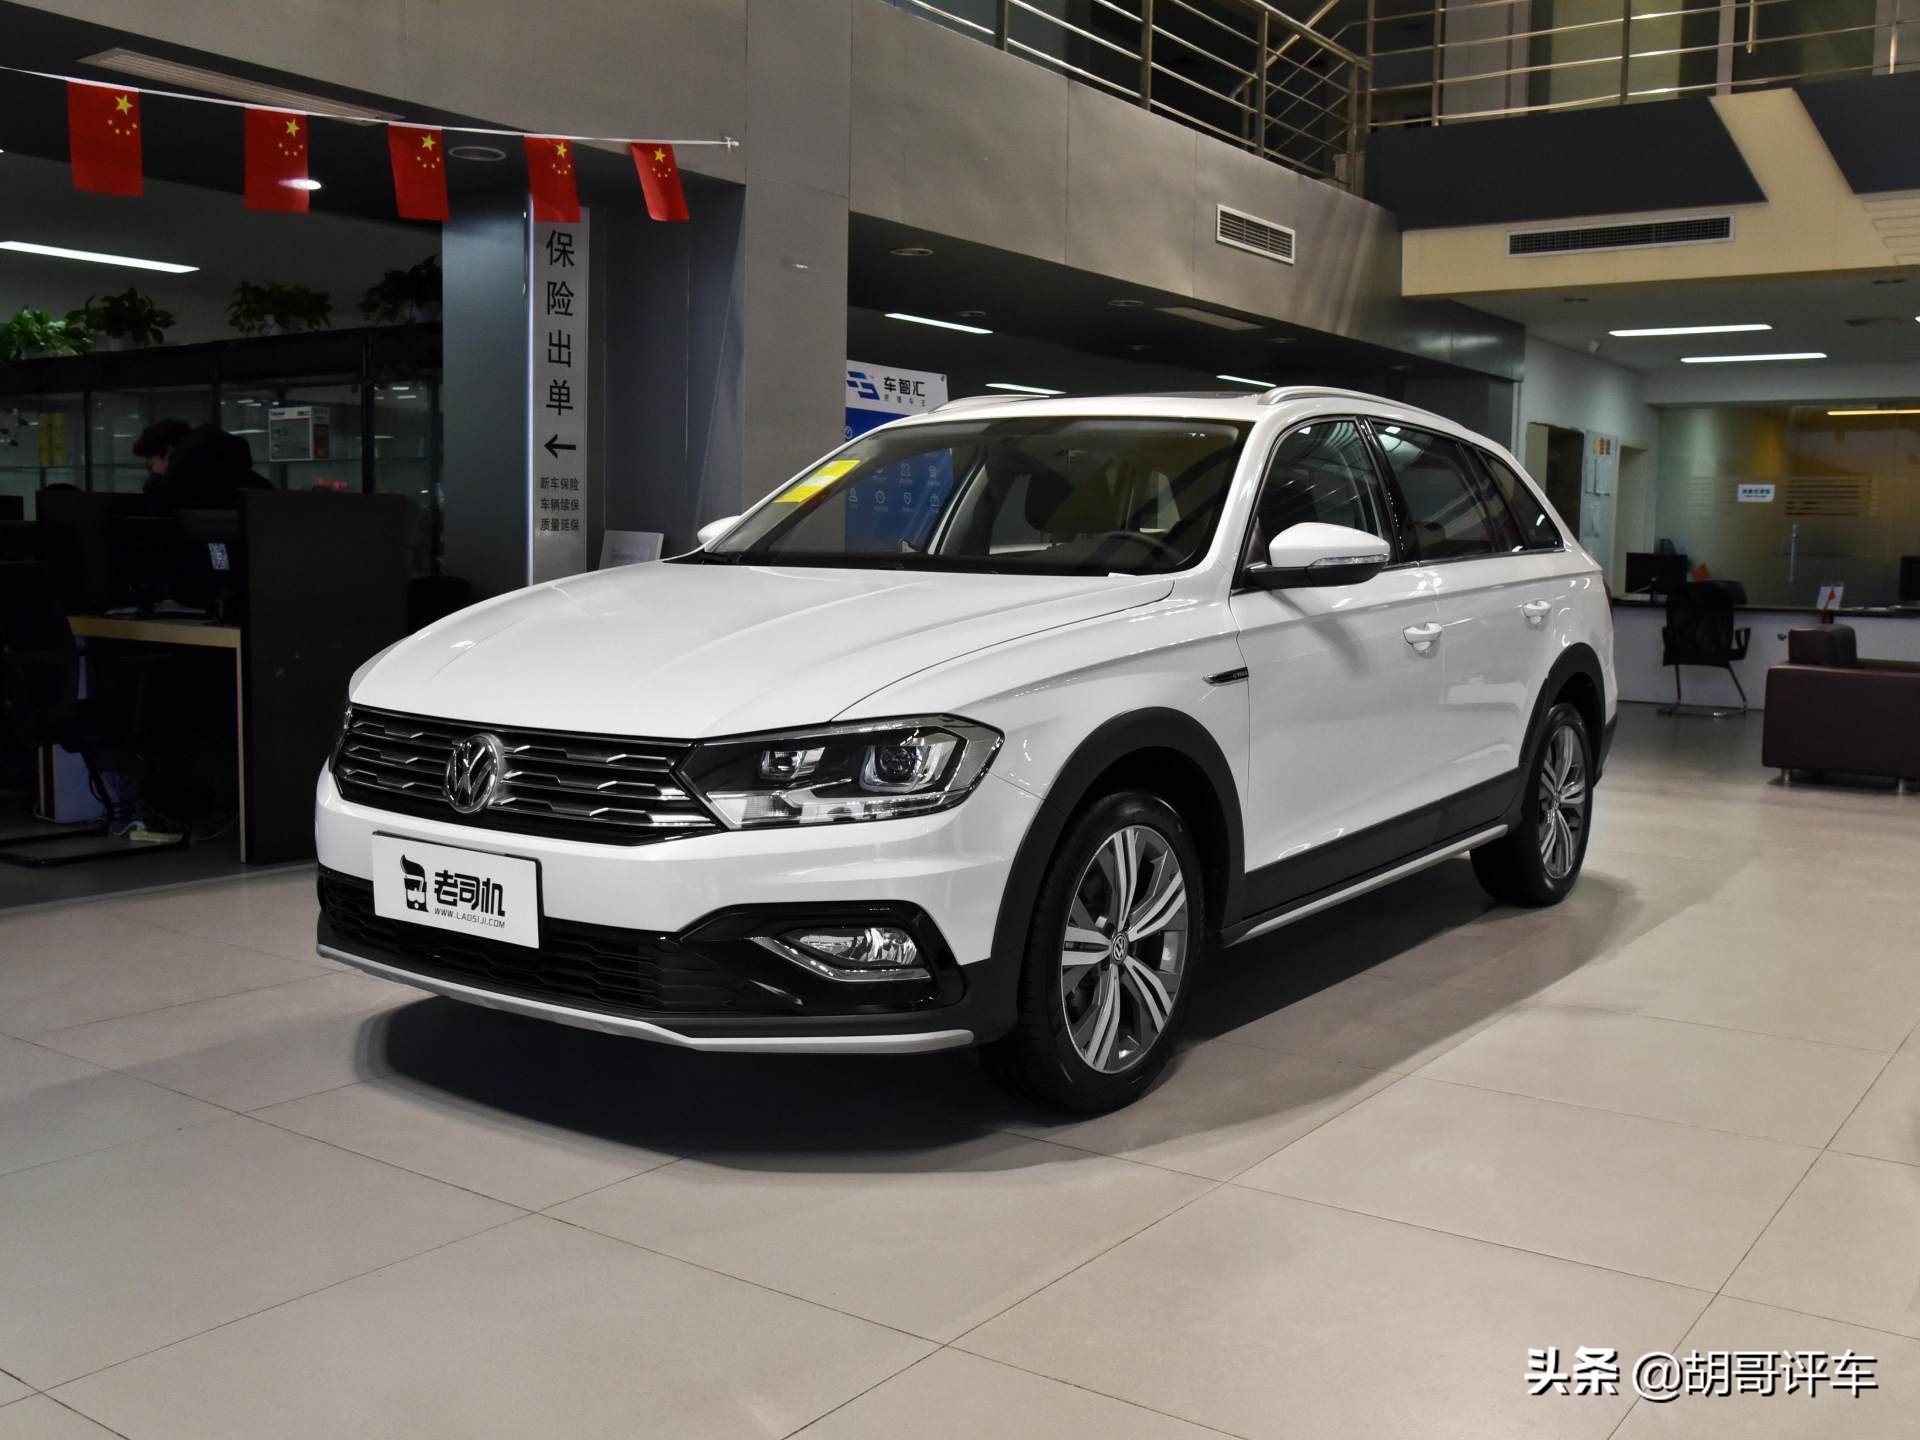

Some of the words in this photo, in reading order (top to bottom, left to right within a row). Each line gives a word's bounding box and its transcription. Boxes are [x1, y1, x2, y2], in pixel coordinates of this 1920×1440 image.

[546, 229, 575, 417] 保险出单
[434, 869, 506, 917] 老司机
[434, 907, 506, 928] WWW.LAOSIJI.COM
